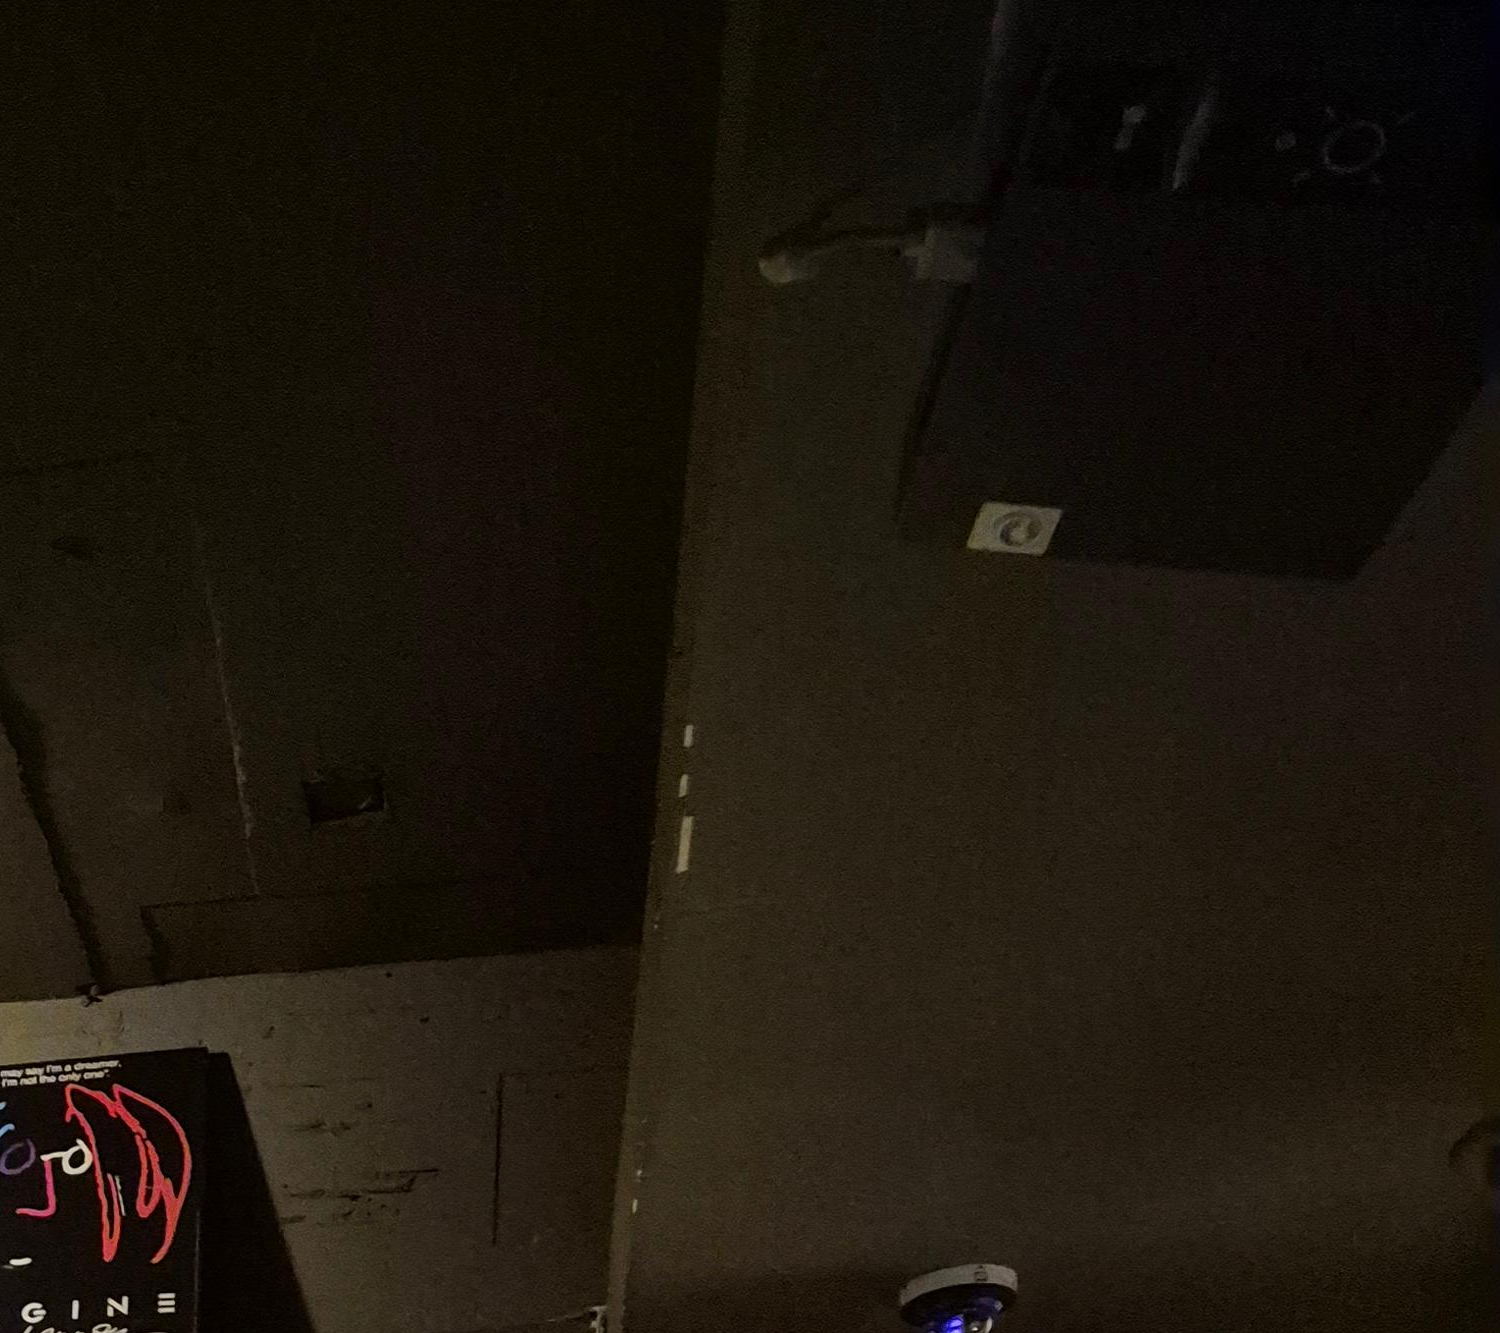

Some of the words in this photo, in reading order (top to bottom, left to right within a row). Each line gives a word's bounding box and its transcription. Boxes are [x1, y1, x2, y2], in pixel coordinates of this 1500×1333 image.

[0, 1069, 24, 1079] may
[25, 1067, 45, 1077] say
[64, 1064, 72, 1072] a
[19, 1075, 38, 1086] not
[39, 1073, 56, 1084] the
[58, 1072, 82, 1082] only
